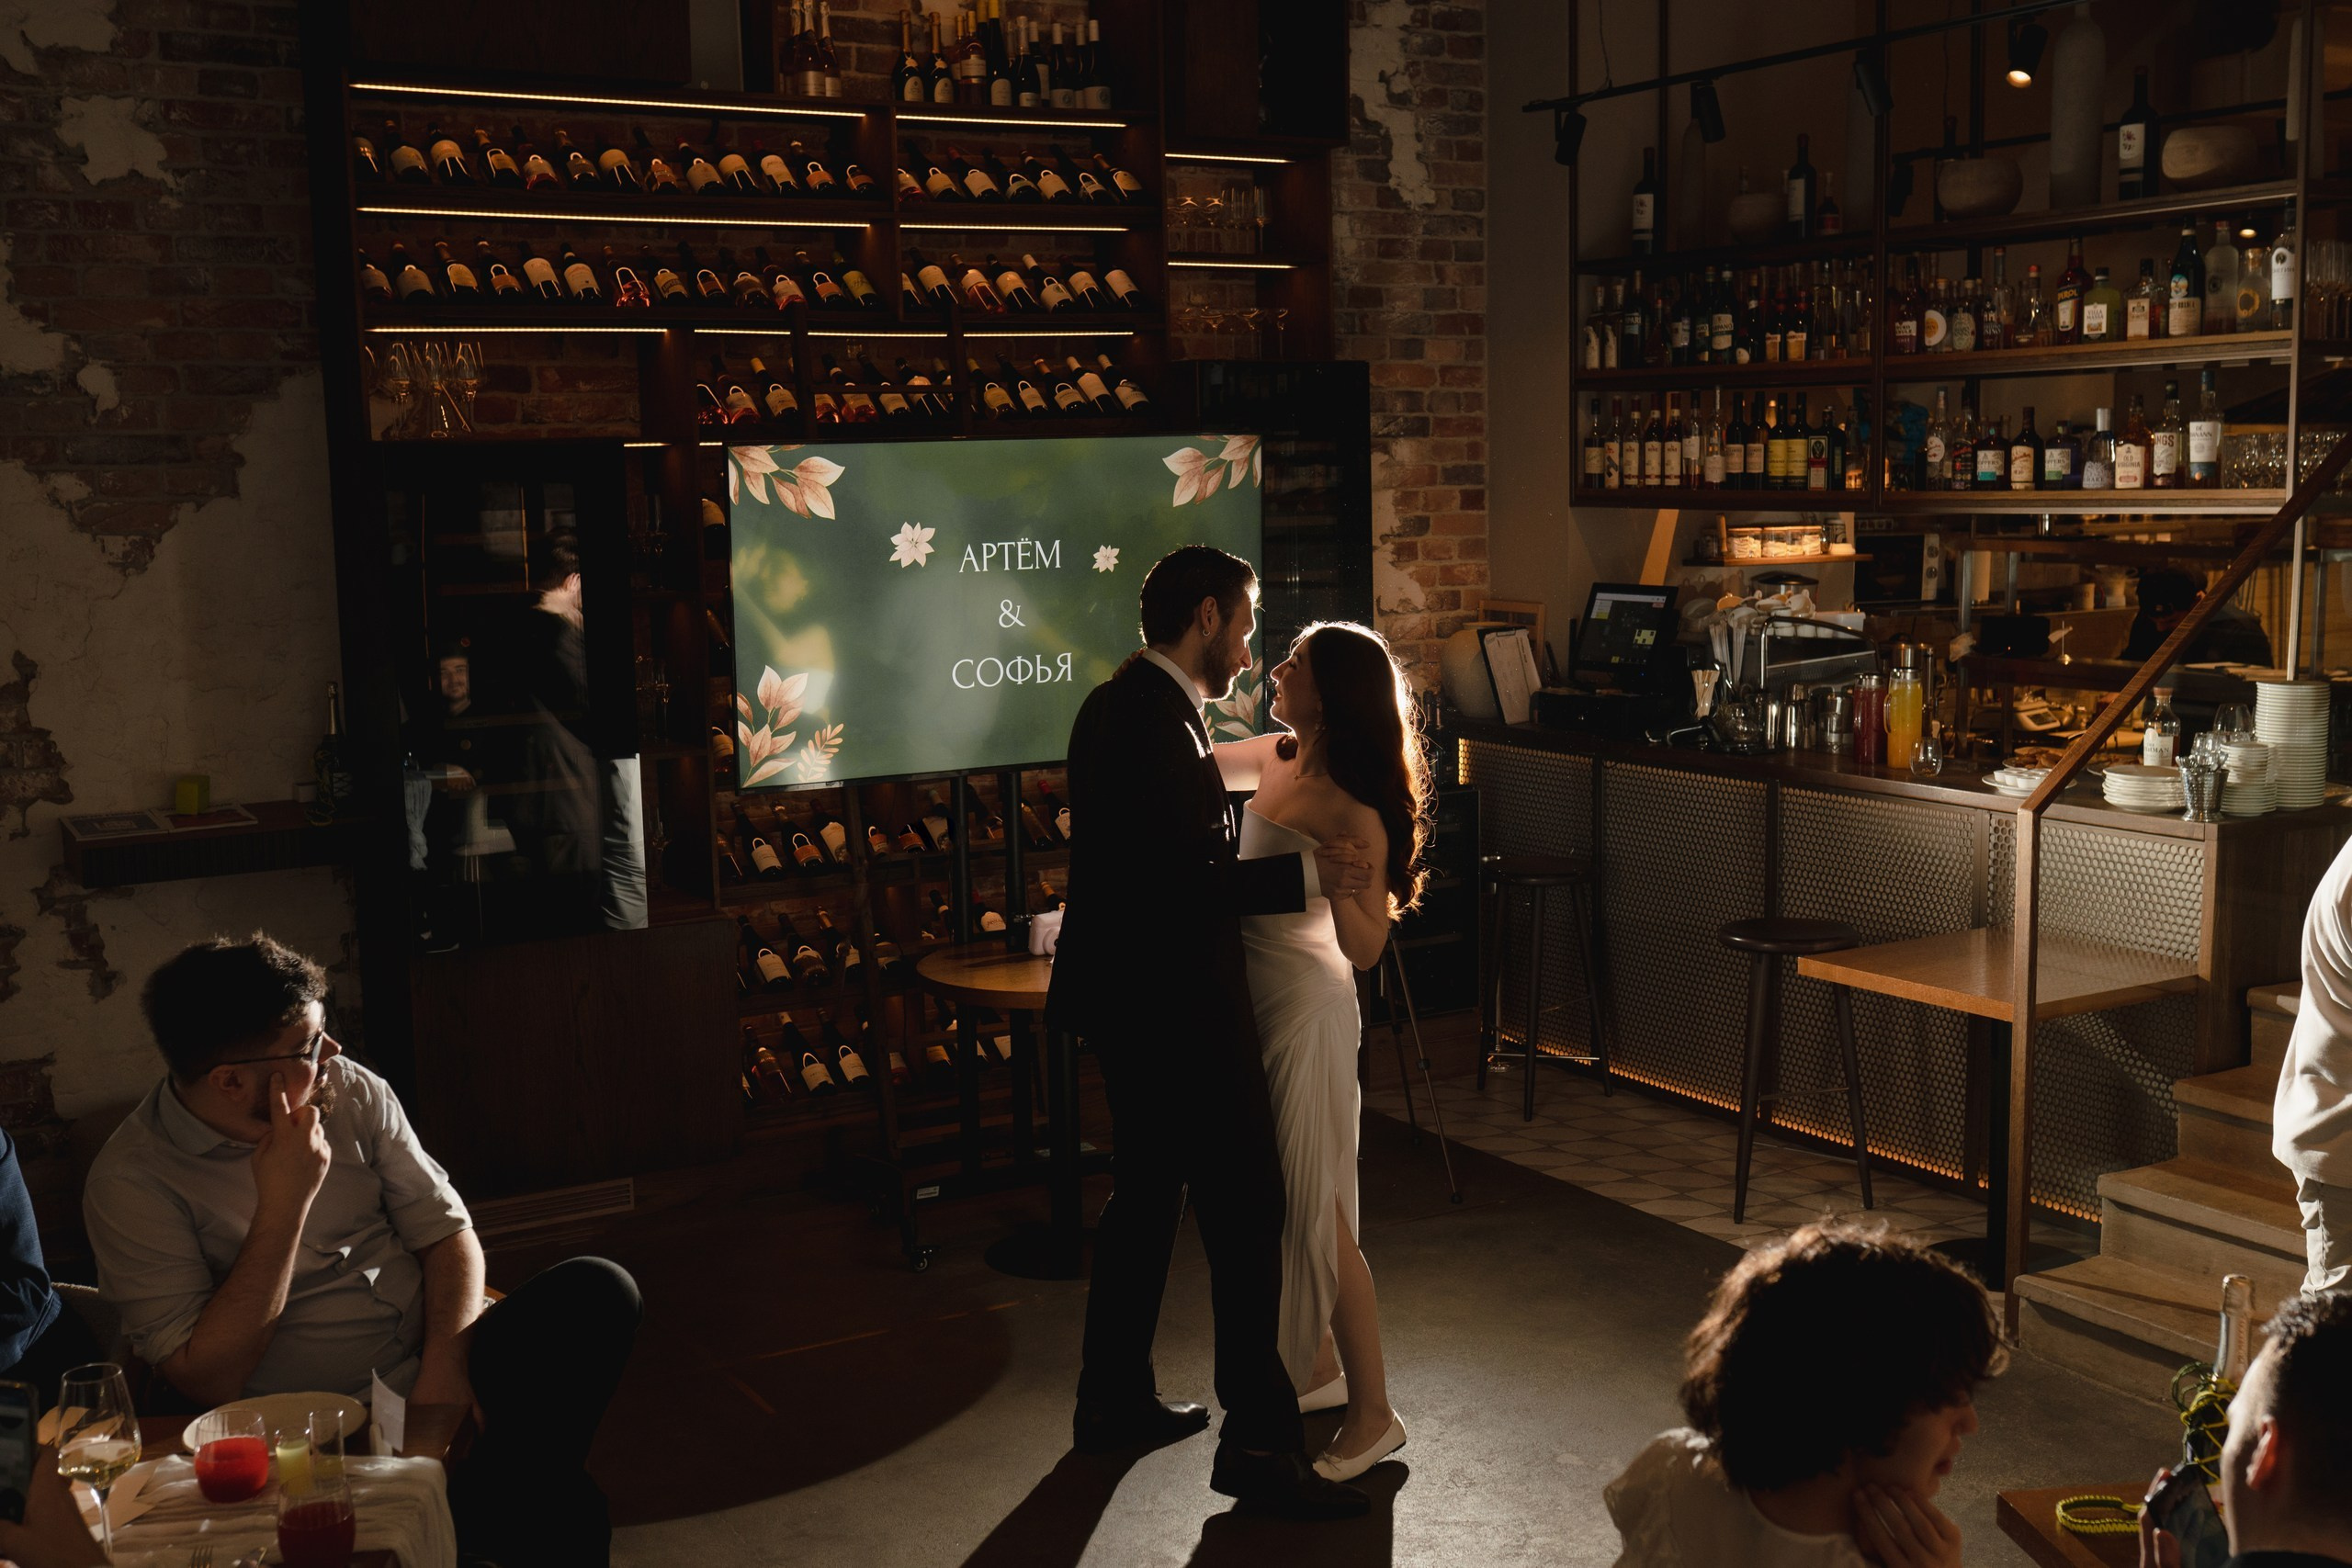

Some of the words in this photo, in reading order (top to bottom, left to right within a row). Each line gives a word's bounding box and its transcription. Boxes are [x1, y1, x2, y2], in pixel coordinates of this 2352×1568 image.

[958, 537, 1061, 573] АРТЁМ
[998, 599, 1026, 628] &
[952, 652, 1073, 689] СОФЬЯ
